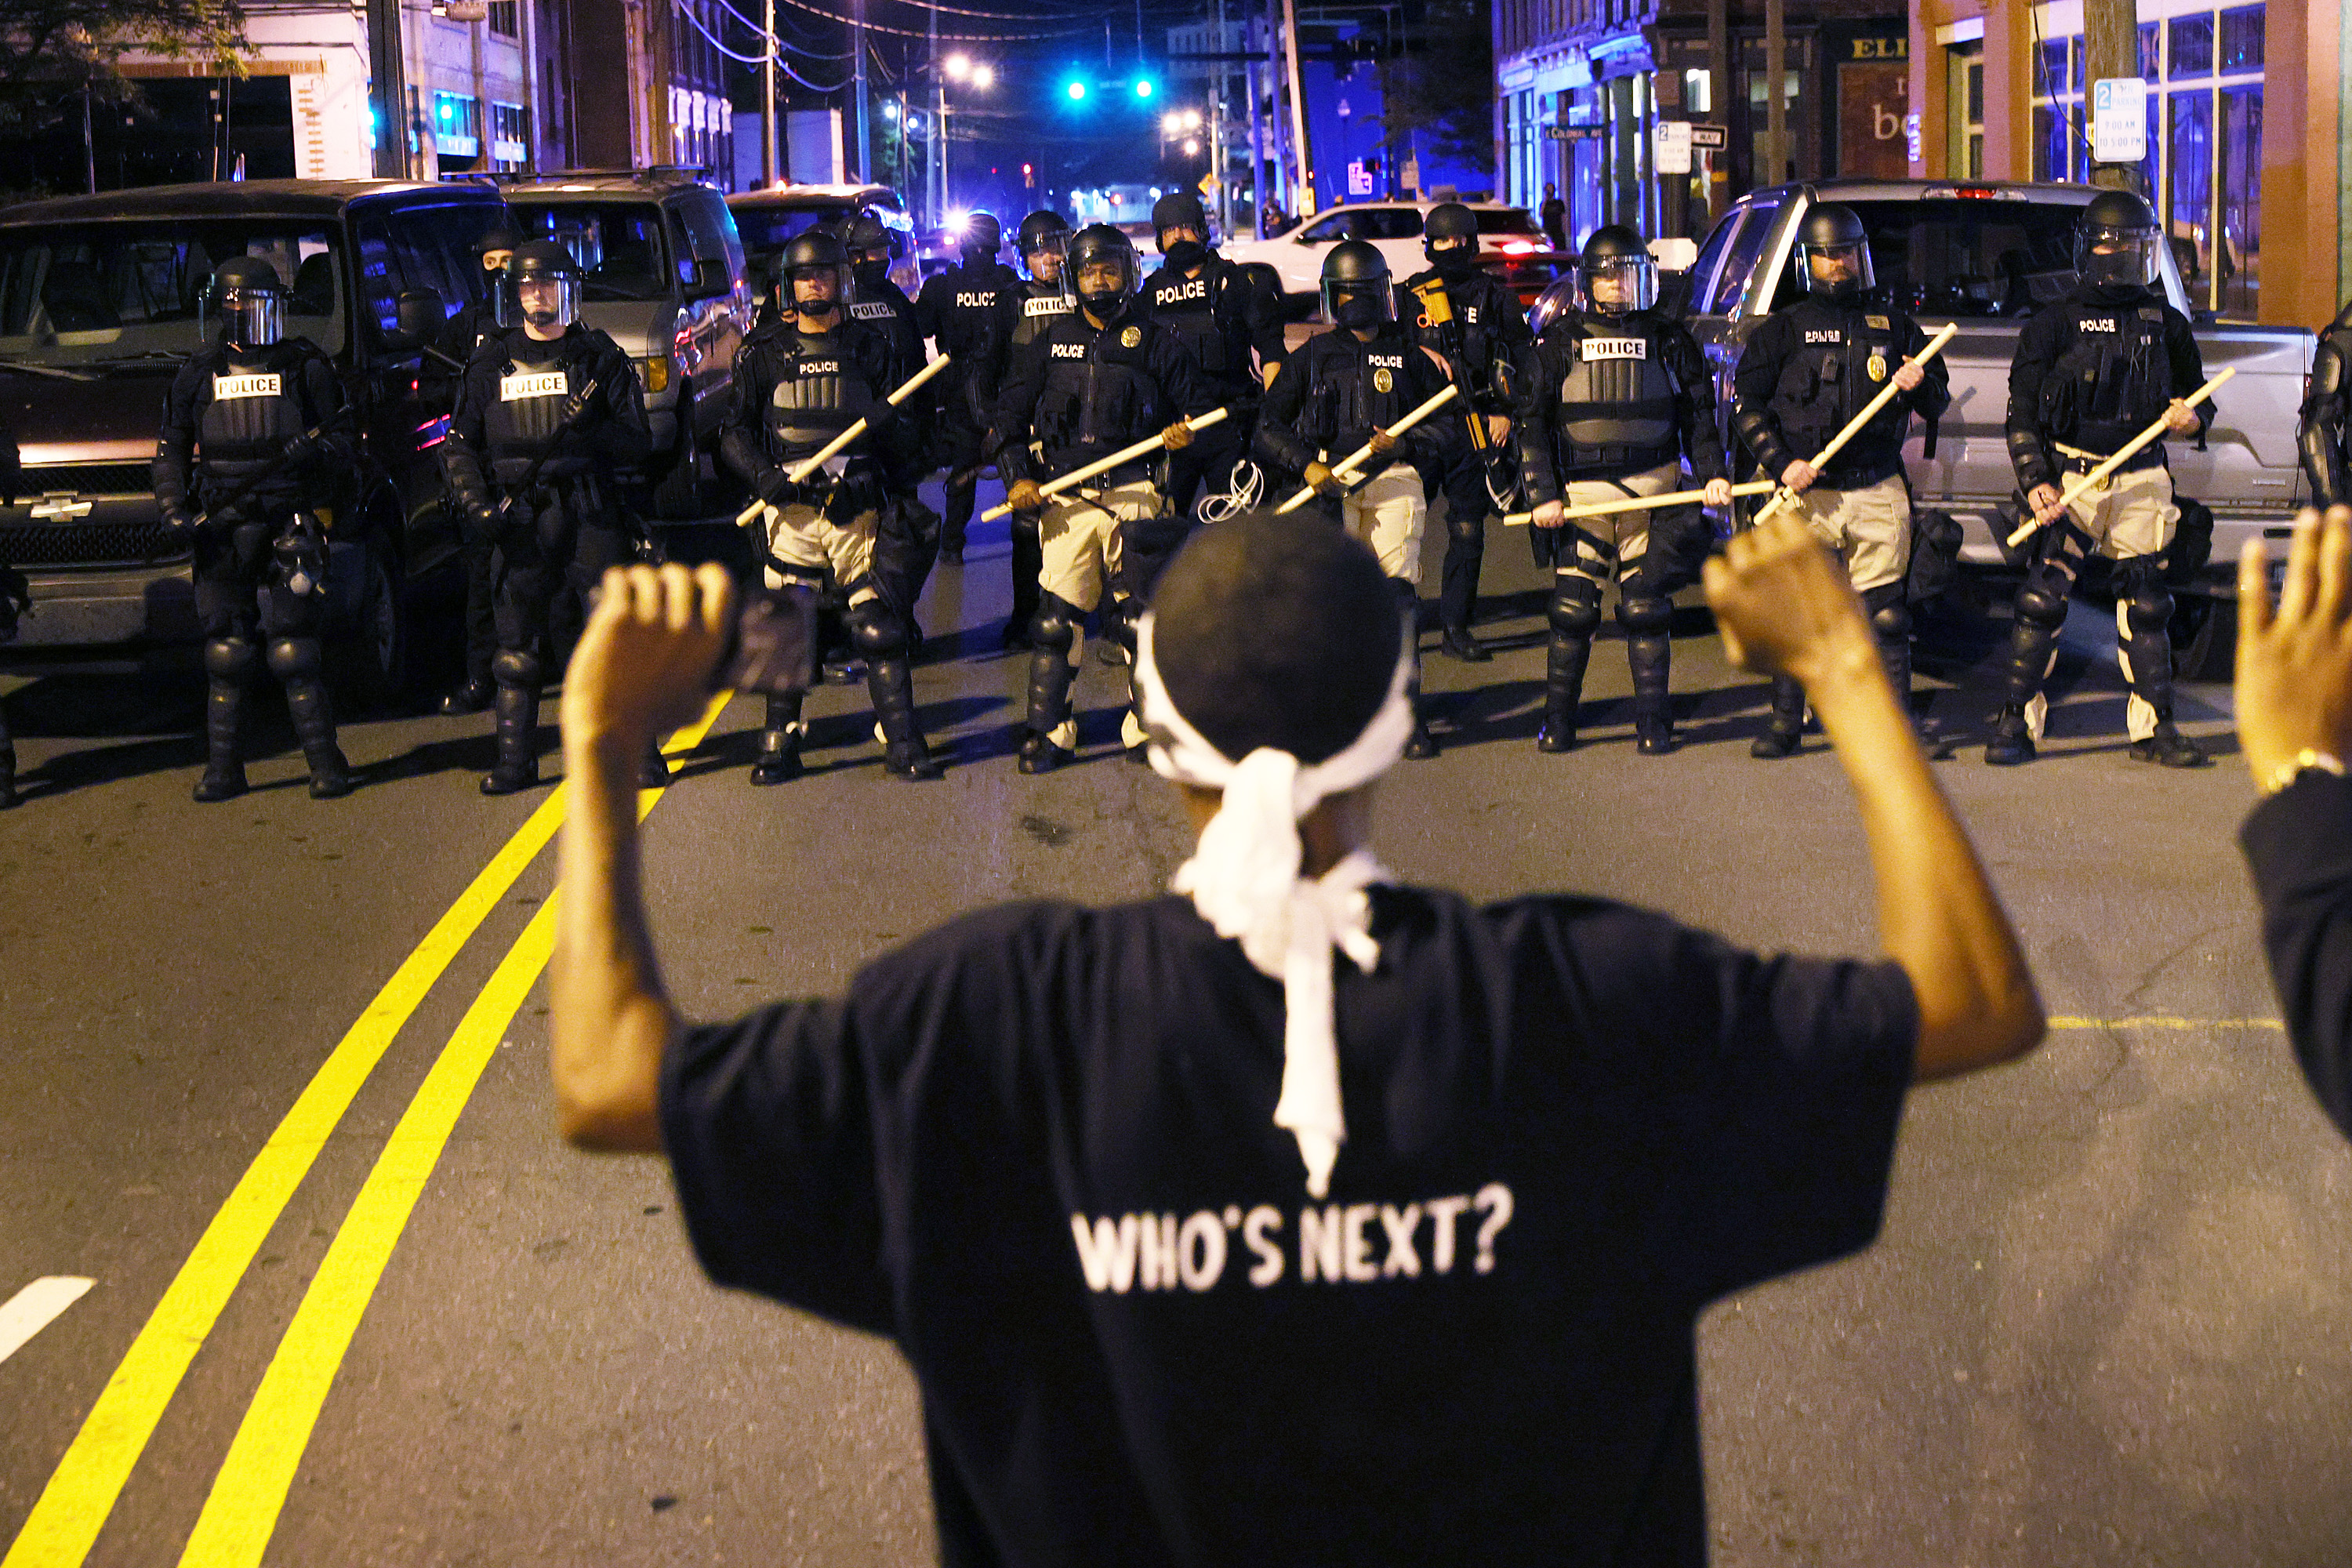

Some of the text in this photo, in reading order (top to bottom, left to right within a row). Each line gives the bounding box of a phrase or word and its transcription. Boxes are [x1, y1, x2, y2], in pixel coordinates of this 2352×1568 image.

[2098, 85, 2110, 107] 2
[2112, 97, 2142, 107] PARKING
[2125, 120, 2135, 129] AM
[1660, 126, 1667, 140] 2
[1699, 131, 1719, 144] WAY
[2131, 137, 2141, 146] PM
[1156, 280, 1206, 306] POLICE
[2079, 318, 2116, 332] POLICE
[1051, 343, 1085, 358] POLICE
[1586, 342, 1642, 356] POLICE
[800, 361, 839, 375] POLICE
[1368, 354, 1403, 368] POLICE
[220, 379, 277, 394] POLICE
[505, 377, 562, 394] POLICE
[1071, 1182, 1514, 1294] WHO'S NEXT?
